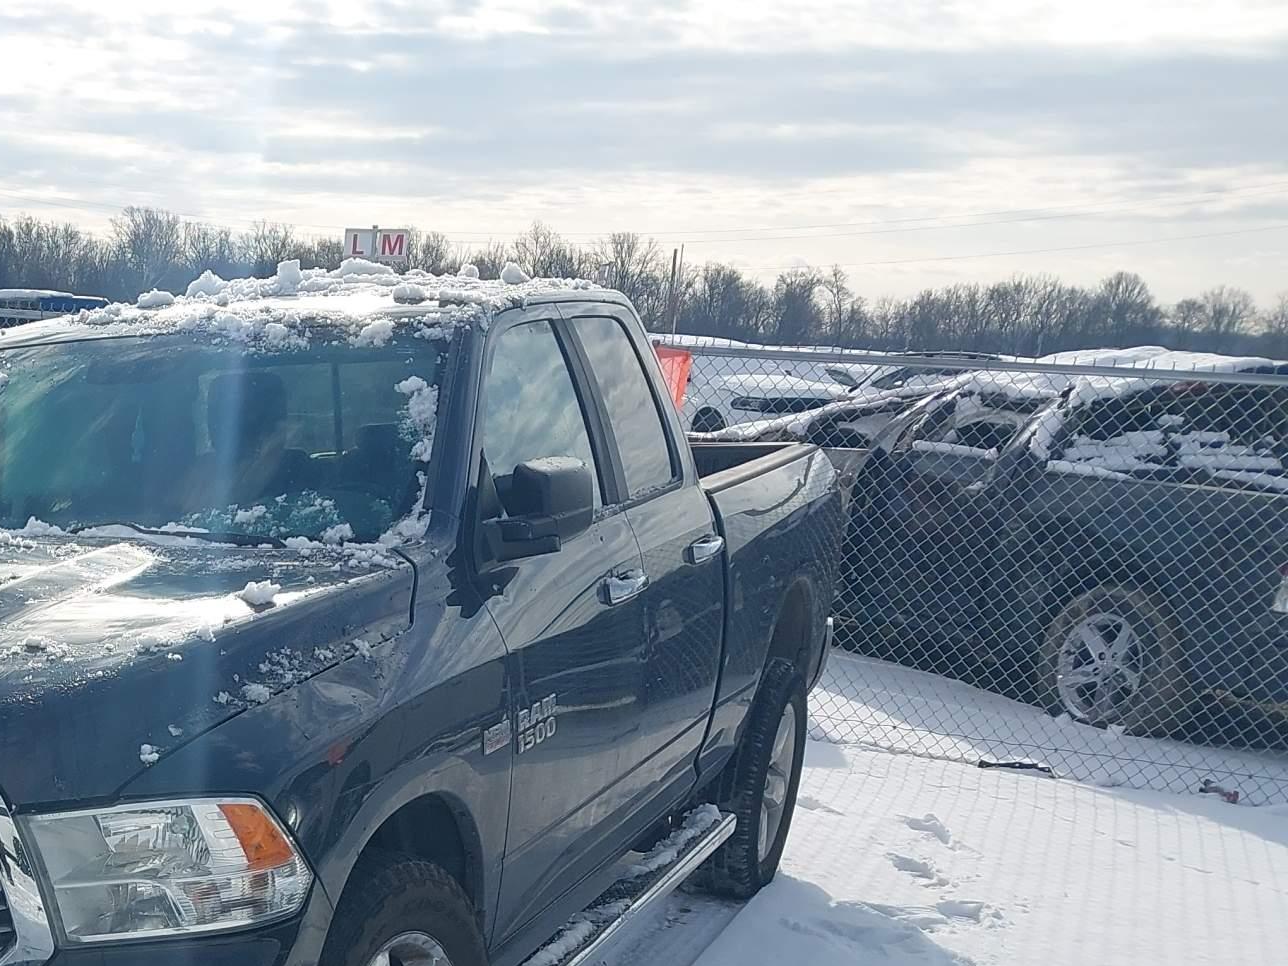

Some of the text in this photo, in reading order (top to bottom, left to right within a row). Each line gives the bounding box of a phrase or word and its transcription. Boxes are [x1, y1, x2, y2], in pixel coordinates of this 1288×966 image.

[352, 233, 405, 256] L M
[518, 693, 556, 733] RAM
[518, 716, 556, 754] 1500
